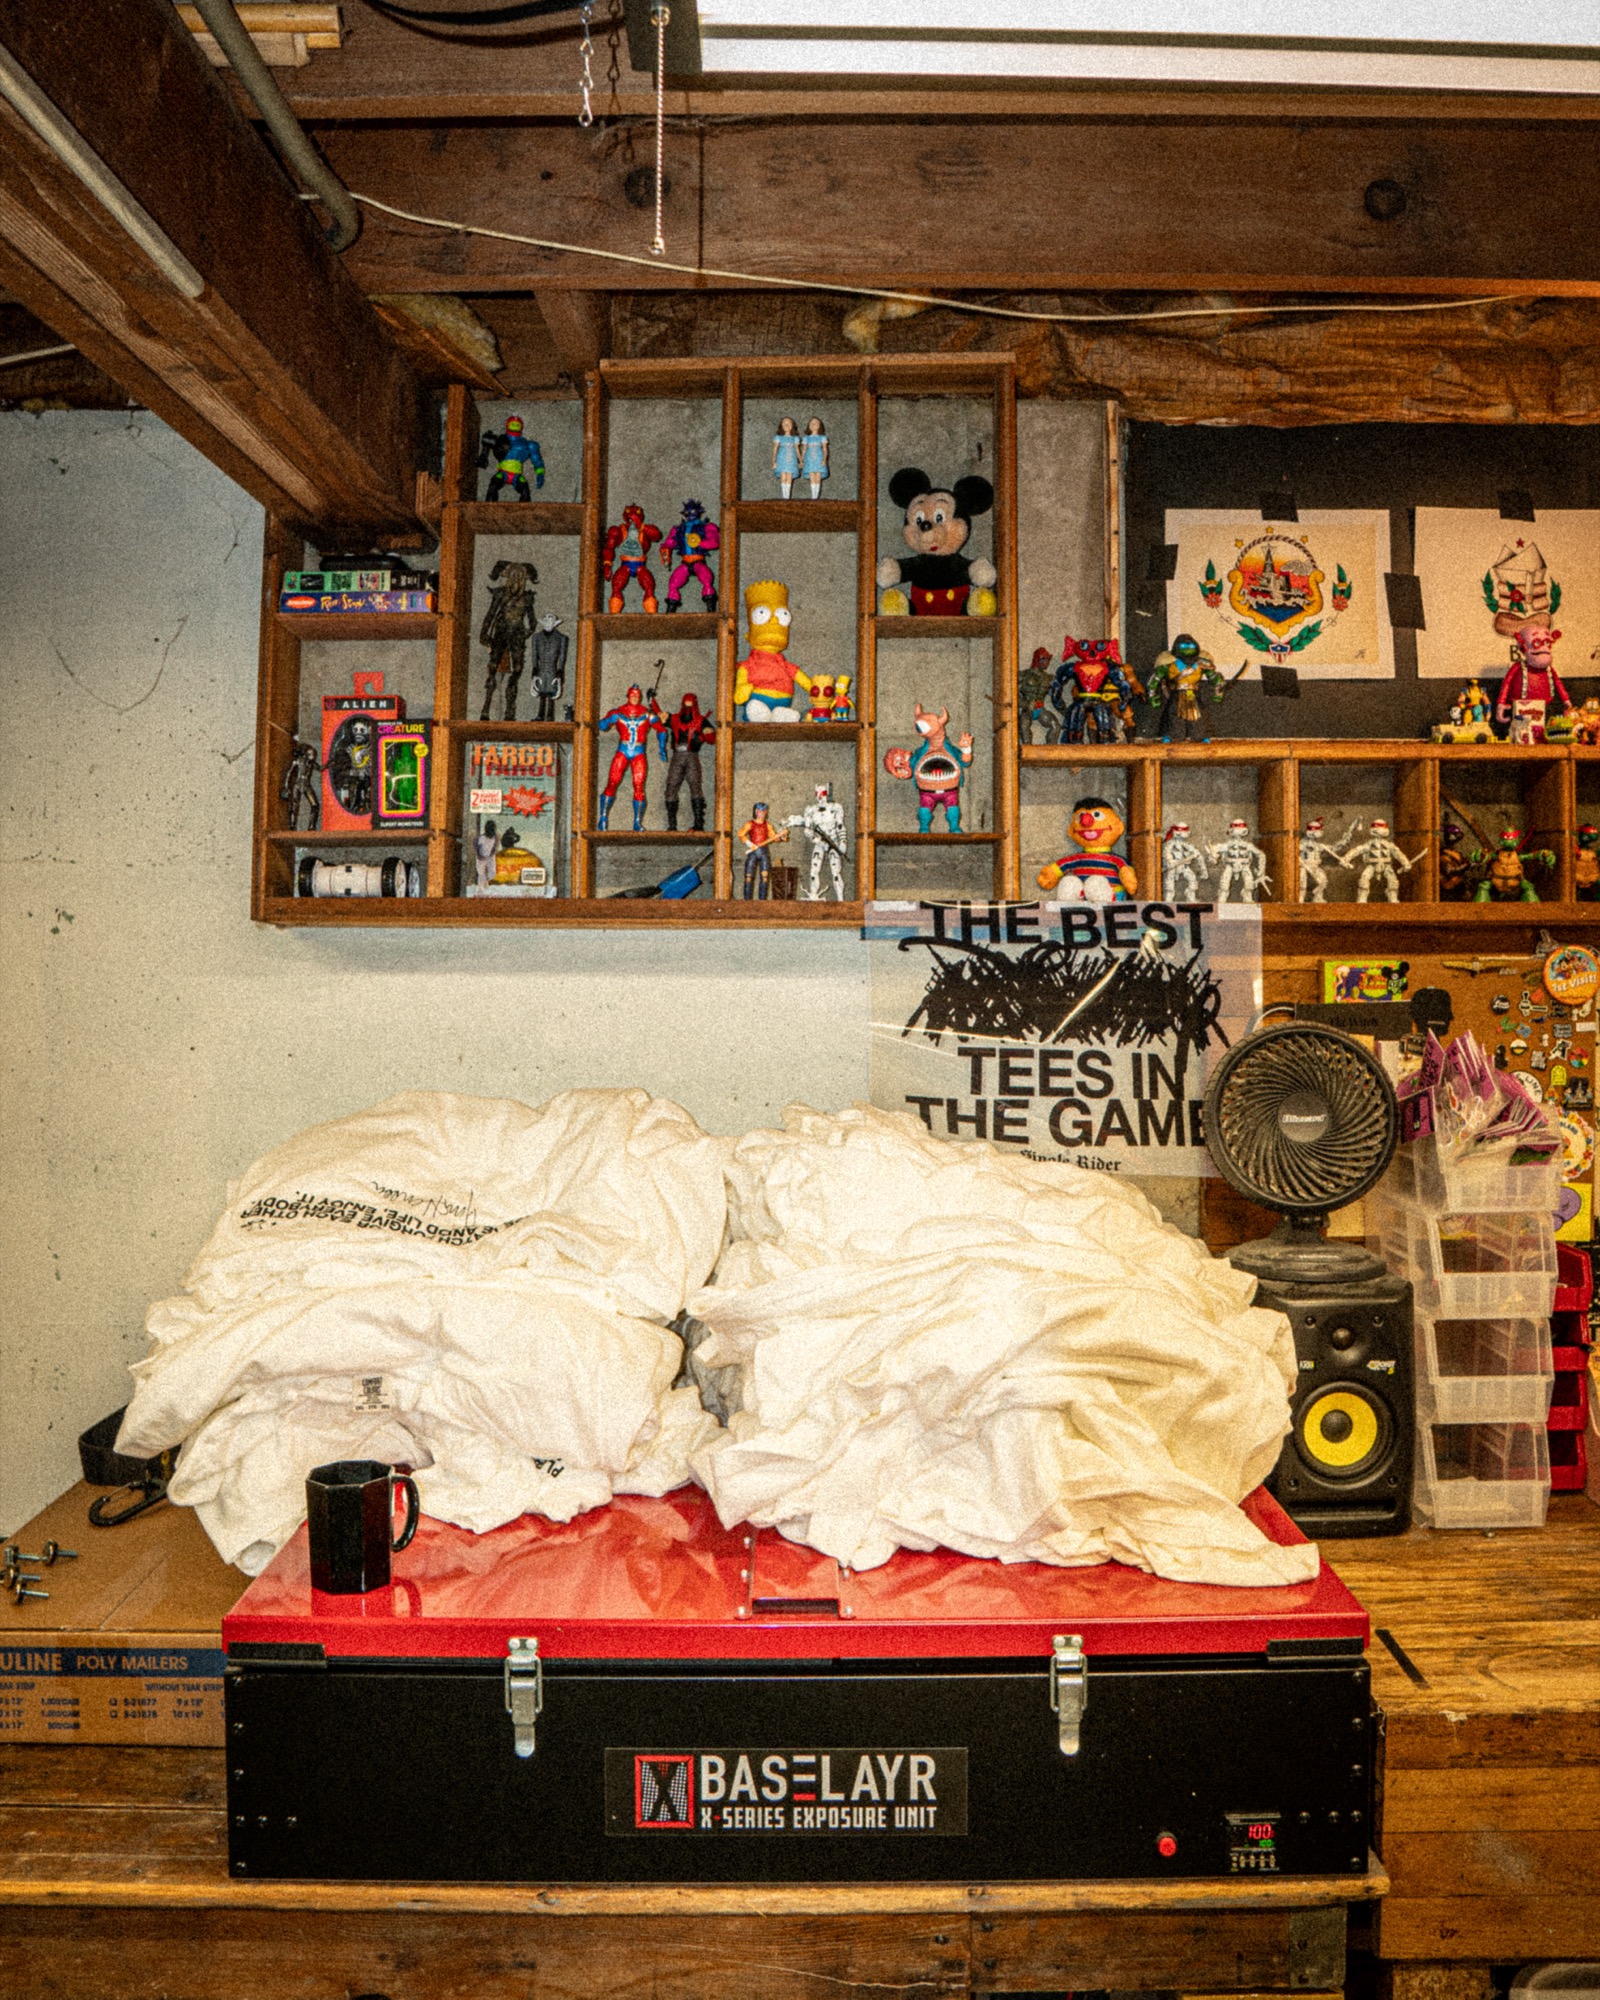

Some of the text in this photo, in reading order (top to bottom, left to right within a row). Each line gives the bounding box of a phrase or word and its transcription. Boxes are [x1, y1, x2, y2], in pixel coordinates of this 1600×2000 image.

[342, 700, 387, 709] ALIEN
[378, 723, 425, 734] CREATURE
[473, 744, 553, 767] FARGO
[471, 792, 480, 807] 2
[919, 901, 1214, 950] THE BEST
[1552, 983, 1568, 993] 1st
[957, 1046, 1185, 1101] TEES IN
[905, 1095, 1206, 1147] THE GAME
[1076, 1154, 1122, 1171] Rider
[240, 1207, 299, 1219] OTHER
[295, 1191, 378, 1215] ENJOY IT.
[382, 1208, 423, 1229] LIFE,
[0, 1652, 189, 1672] ULINE POLY MAILERS
[145, 1683, 180, 1692] WITHOUT
[182, 1684, 200, 1692] TEAR
[700, 1754, 938, 1802] BASELAYR
[793, 1806, 888, 1829] EXPOSURE
[894, 1806, 938, 1828] UNIT
